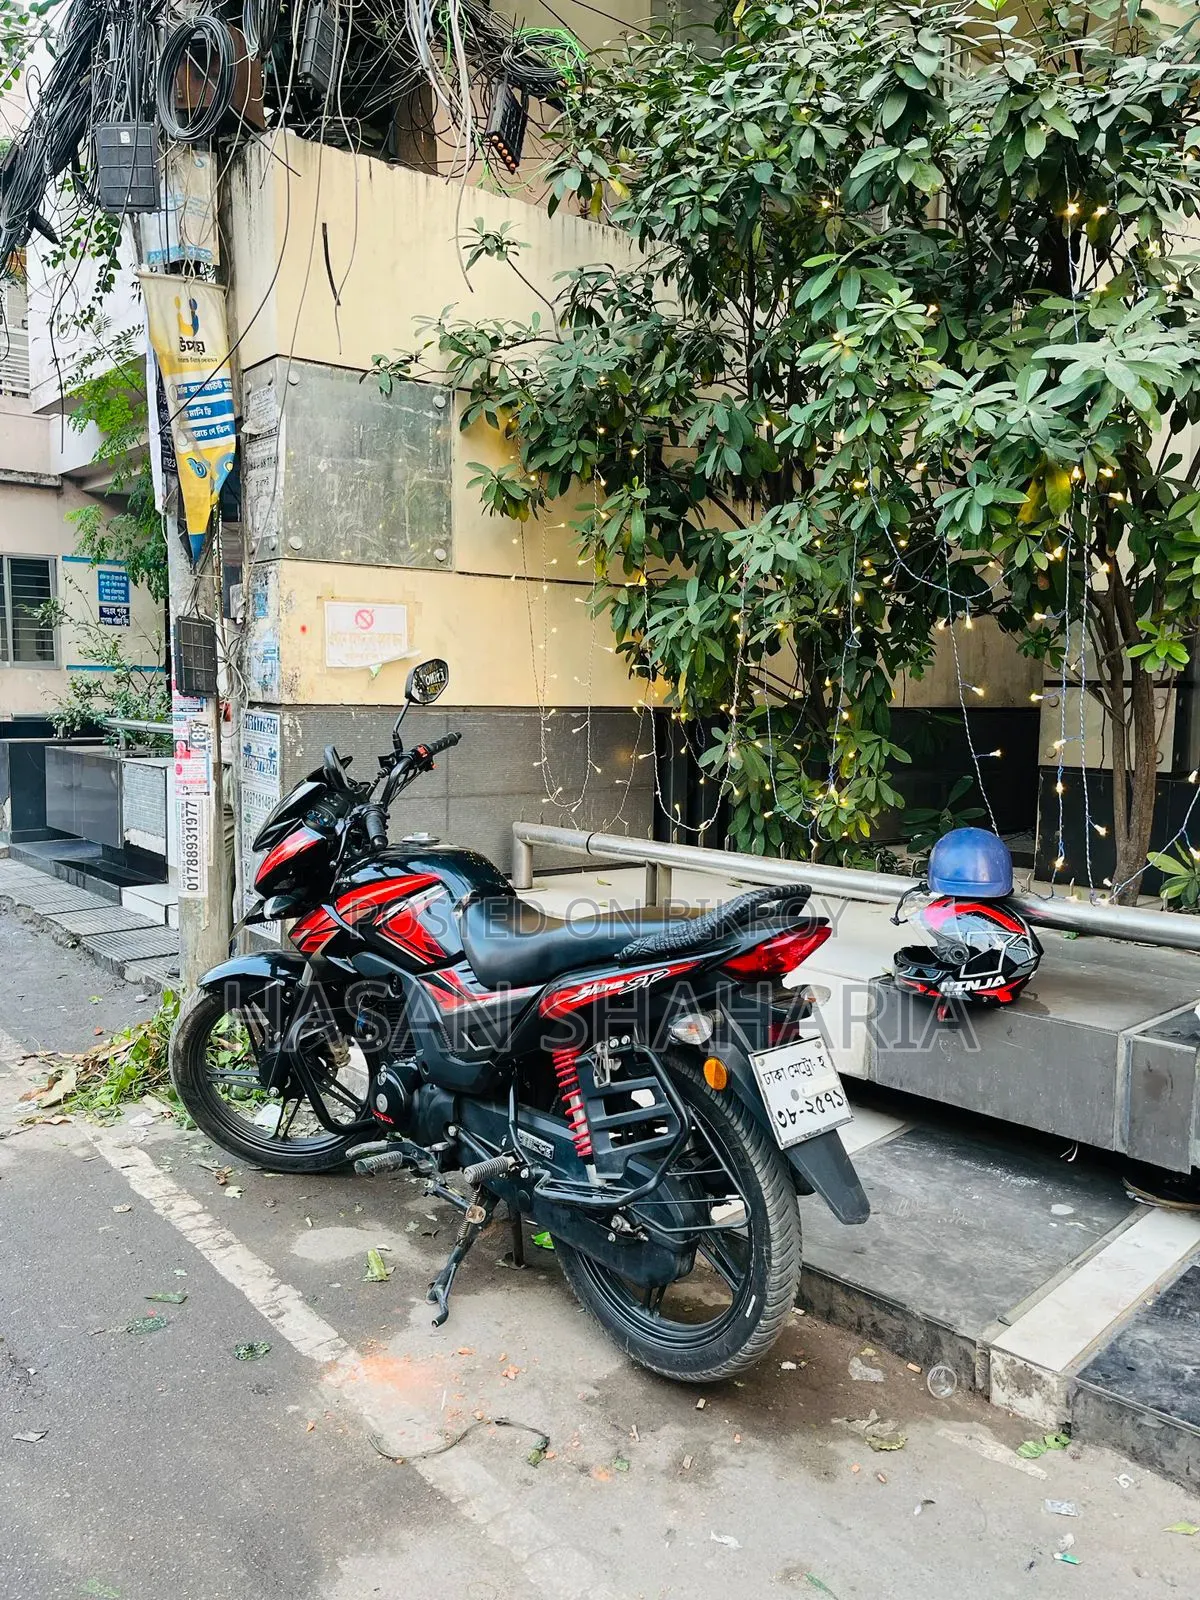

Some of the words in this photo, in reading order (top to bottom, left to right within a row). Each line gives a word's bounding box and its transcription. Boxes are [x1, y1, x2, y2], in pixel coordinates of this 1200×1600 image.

[185, 801, 199, 891] 01788931977
[939, 975, 1006, 992] NINJA
[763, 1067, 787, 1085] ঢাকা
[775, 1090, 844, 1128] ৩৮-২৫৭১
